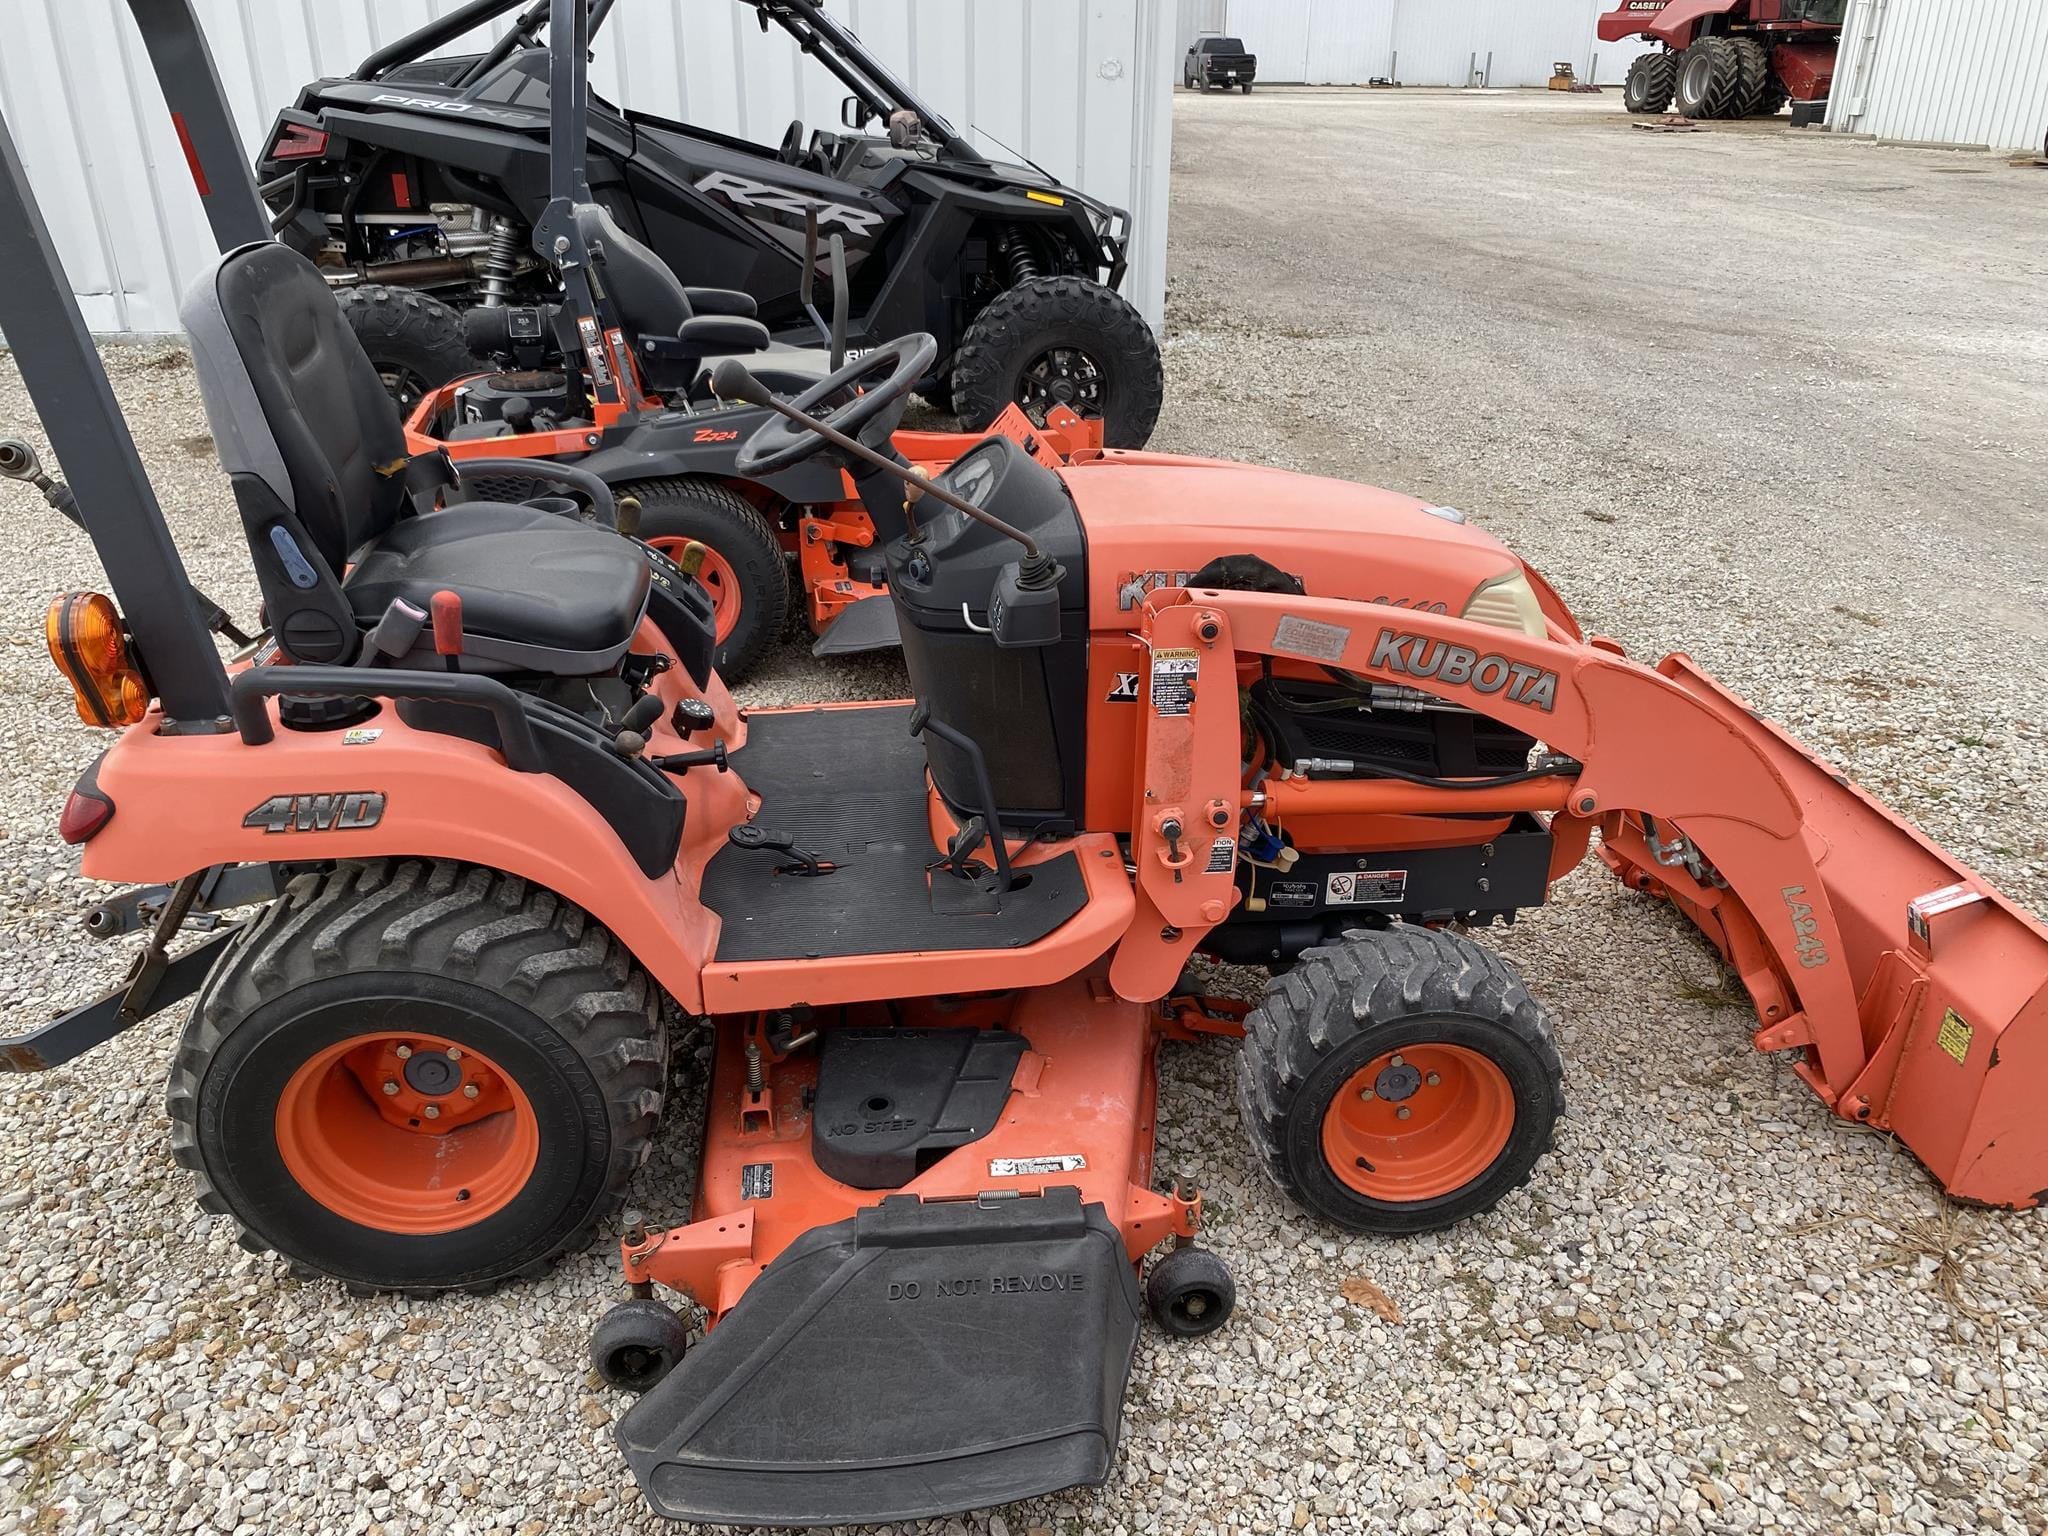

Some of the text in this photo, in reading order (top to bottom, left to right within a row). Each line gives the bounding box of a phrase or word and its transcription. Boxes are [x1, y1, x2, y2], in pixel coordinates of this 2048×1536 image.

[1630, 2, 1656, 10] CASE
[371, 94, 535, 120] PRO XP
[694, 171, 885, 237] RZR
[693, 429, 738, 442] Z724
[1370, 629, 1559, 712] KUBOTA
[243, 792, 386, 833] 4WD
[1781, 886, 1830, 969] LA243
[828, 1119, 917, 1138] NO STEP
[887, 1273, 1085, 1300] DO NOT REMOVE
